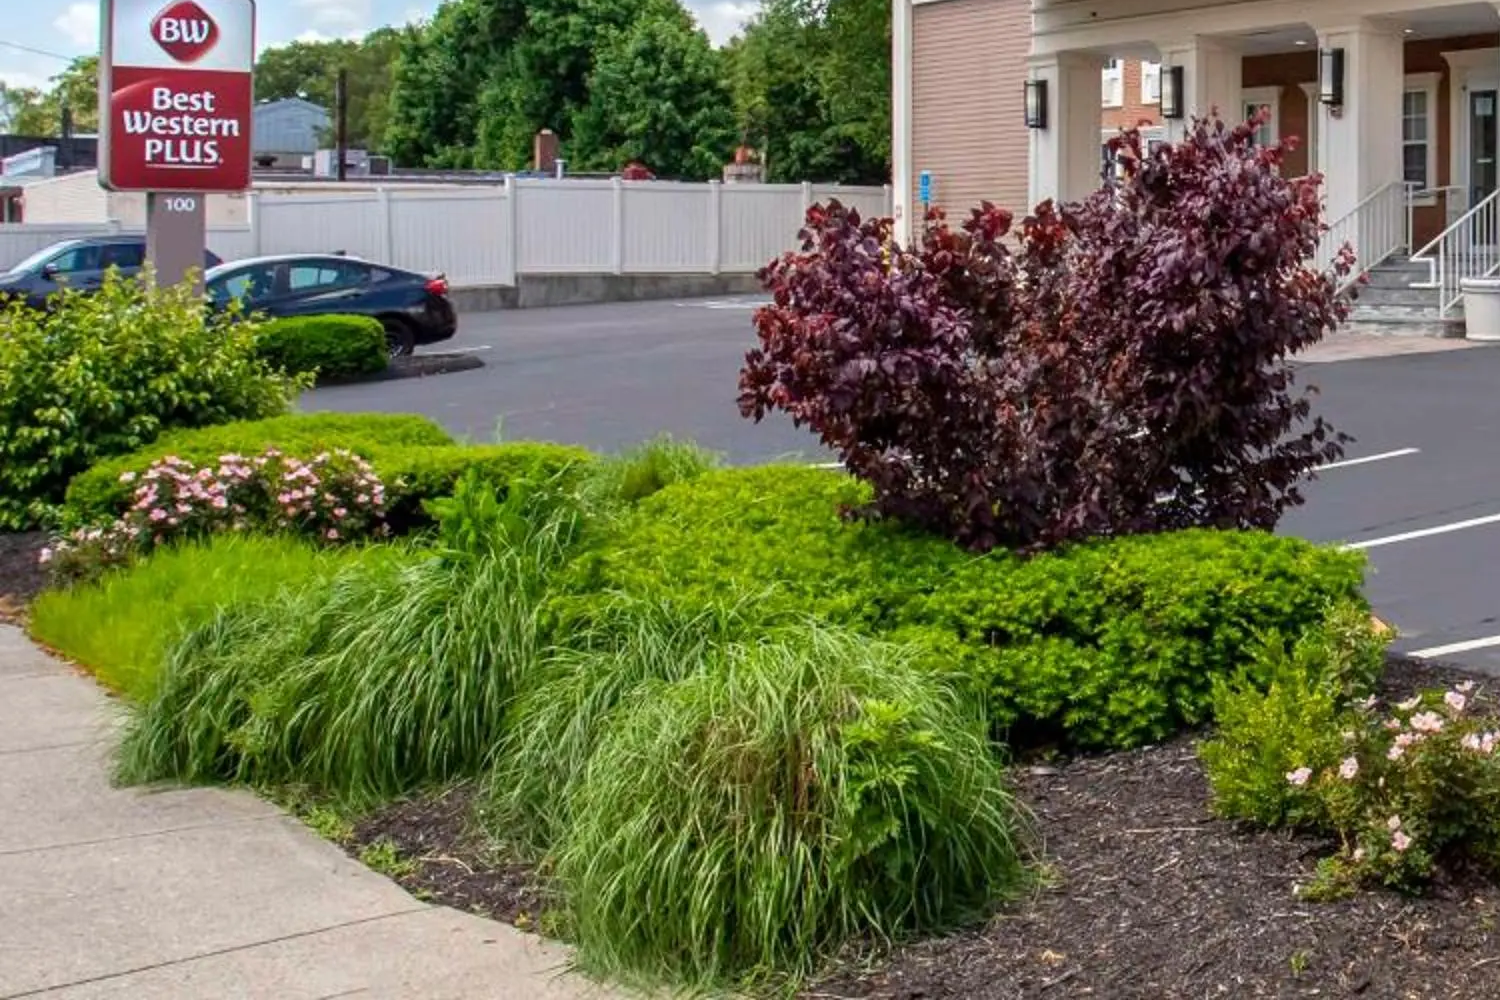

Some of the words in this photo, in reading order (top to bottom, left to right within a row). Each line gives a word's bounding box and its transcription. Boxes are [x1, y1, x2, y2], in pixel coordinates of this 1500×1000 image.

[159, 17, 210, 43] BW
[152, 87, 216, 112] Best
[123, 110, 240, 137] Western
[145, 139, 220, 164] PLUS
[164, 198, 196, 211] 100
